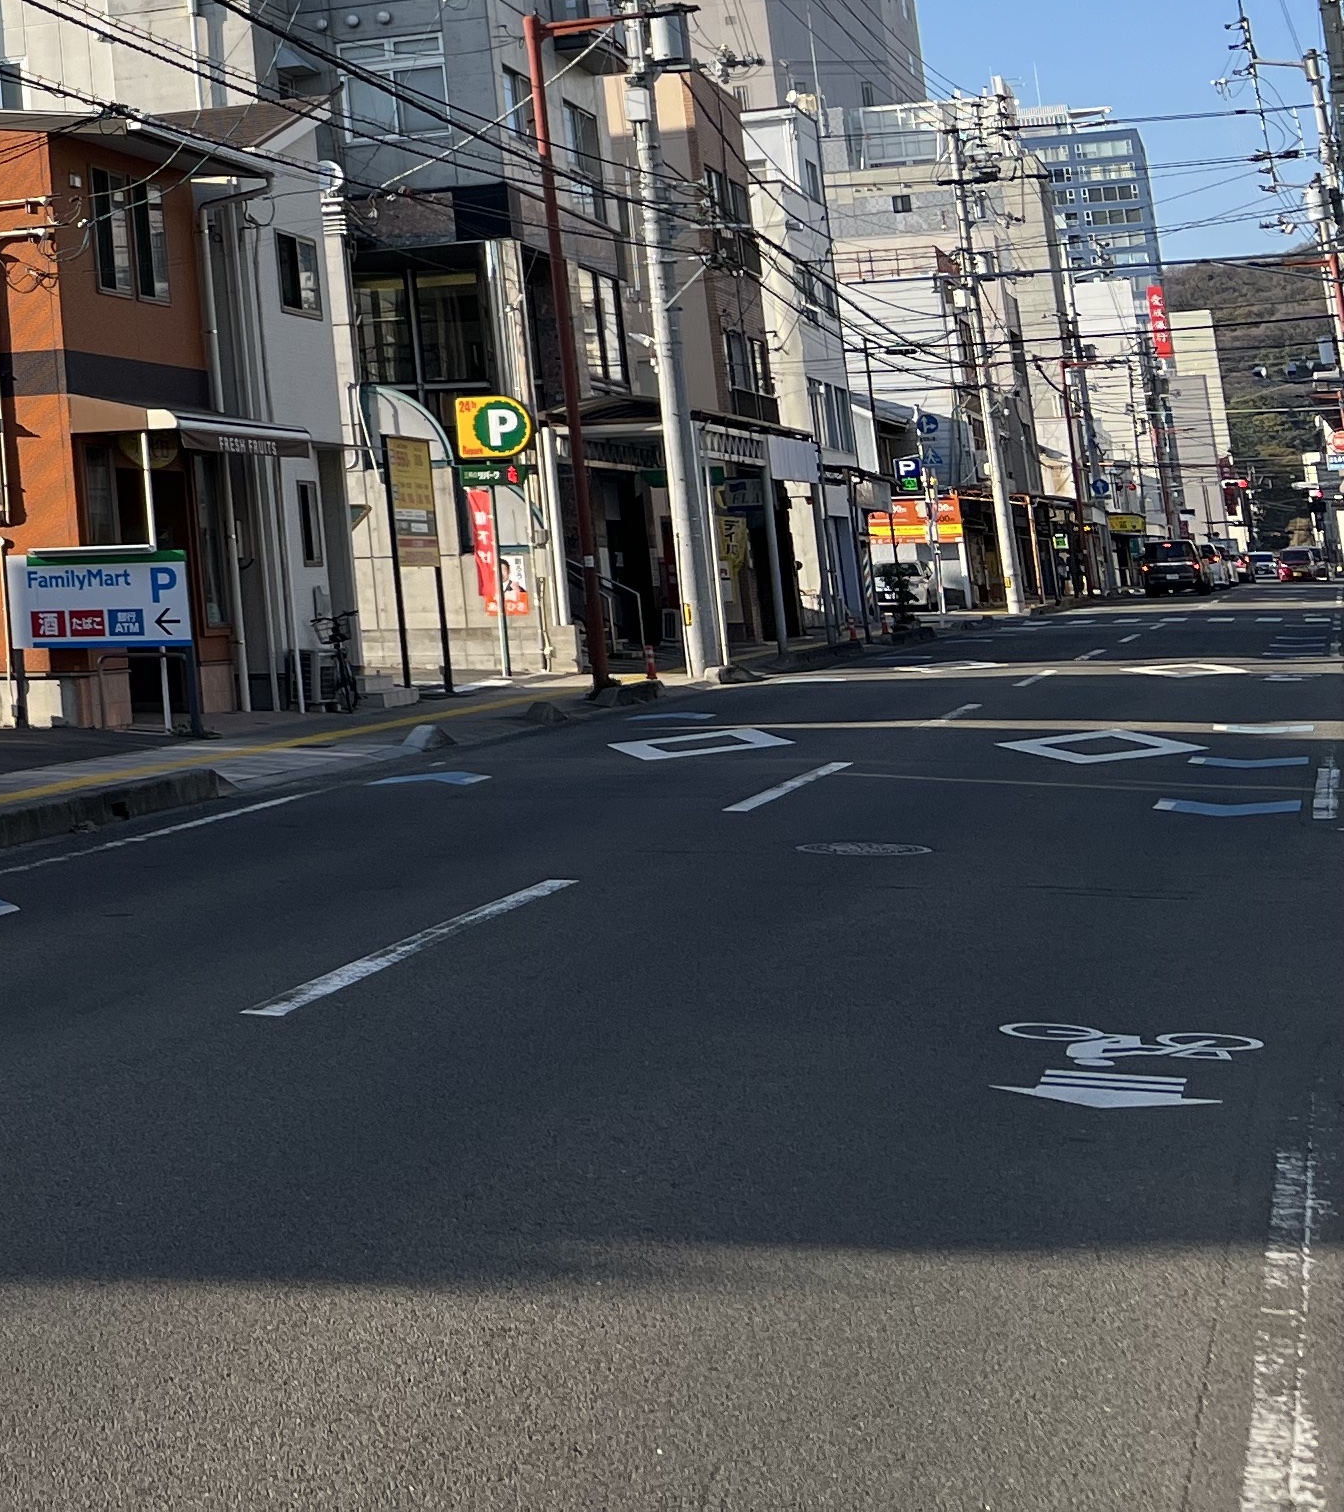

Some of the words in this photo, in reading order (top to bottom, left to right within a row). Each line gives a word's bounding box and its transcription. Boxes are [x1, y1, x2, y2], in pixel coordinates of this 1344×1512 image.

[487, 408, 518, 447] P
[218, 436, 246, 453] FRESH
[248, 439, 278, 456] FRUITS
[898, 460, 916, 476] P
[27, 568, 131, 591] FamilyMart
[149, 567, 177, 604] P
[38, 612, 58, 636] 酒
[71, 616, 103, 631] たばこ
[117, 611, 136, 623] 銀行
[114, 622, 140, 634] ATM
